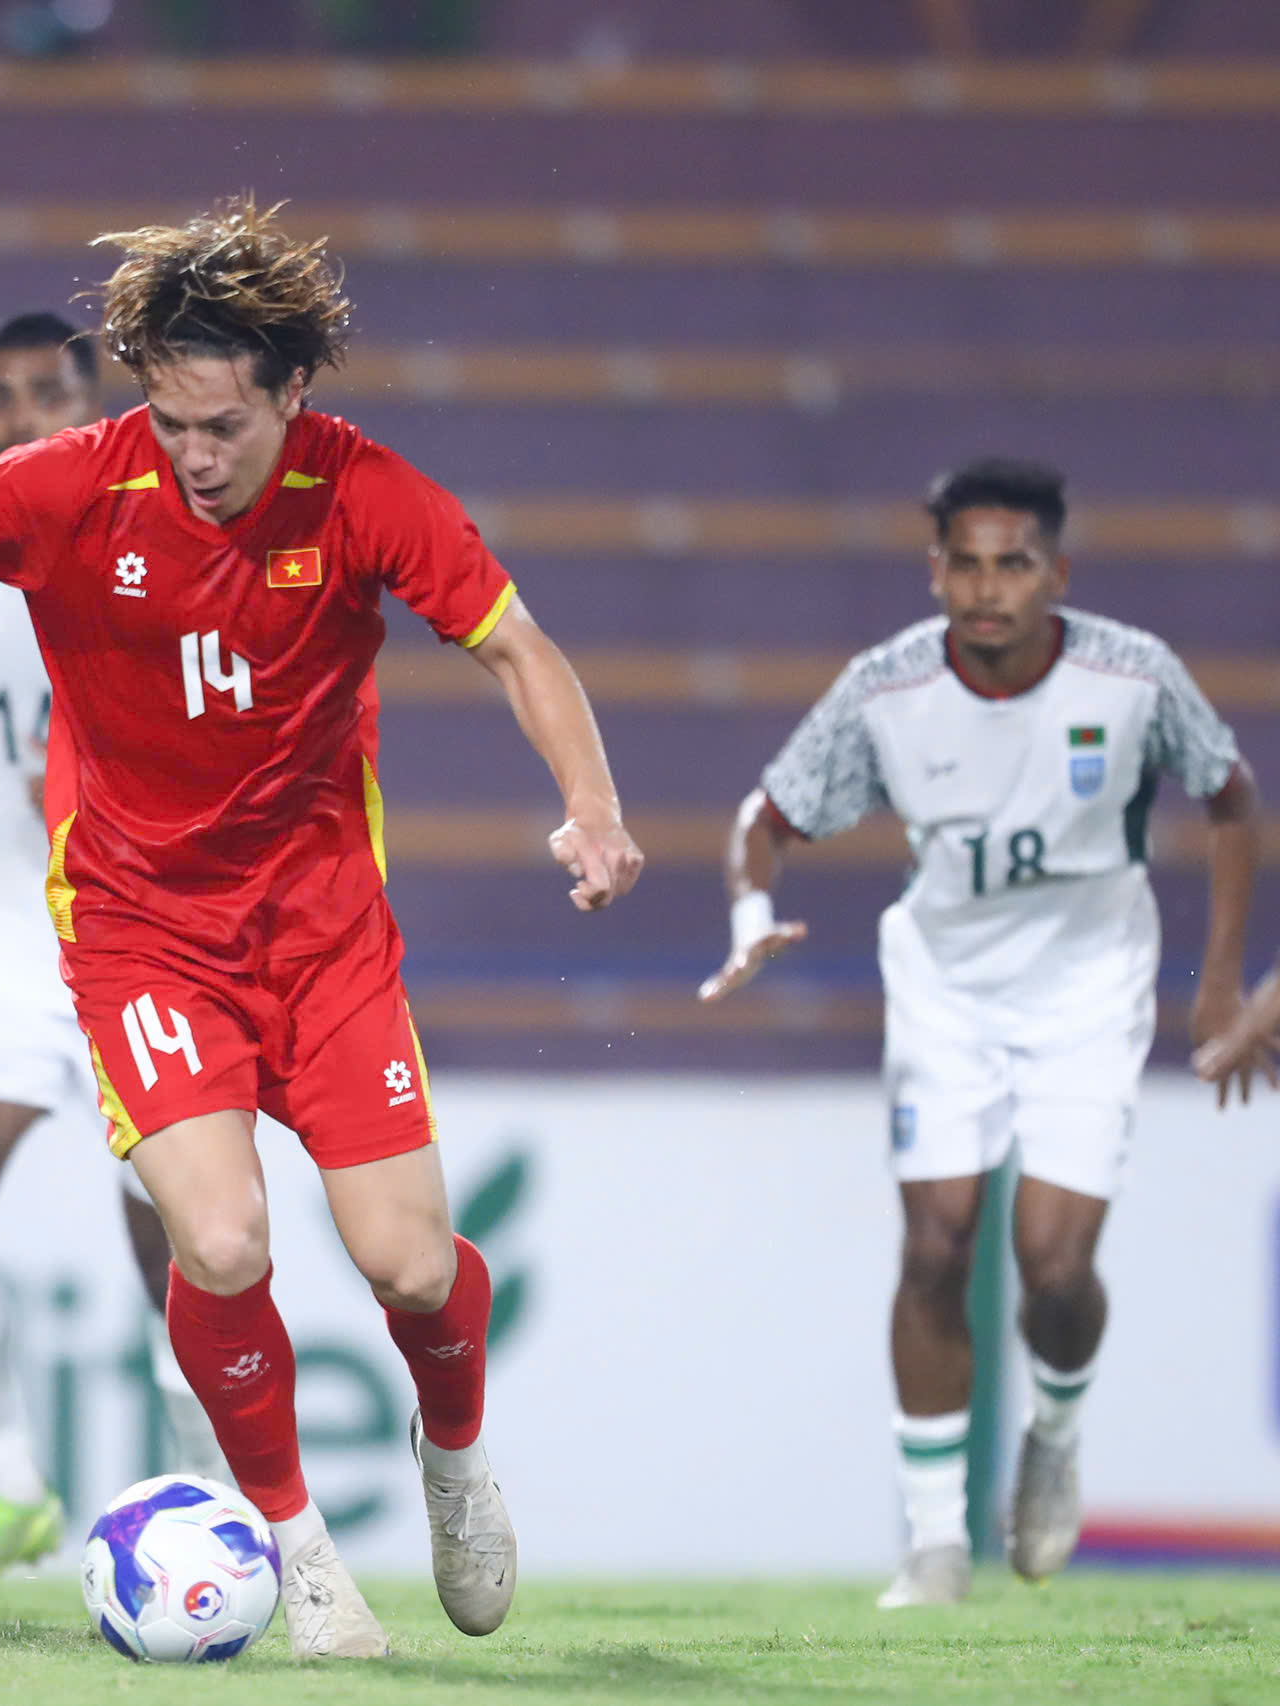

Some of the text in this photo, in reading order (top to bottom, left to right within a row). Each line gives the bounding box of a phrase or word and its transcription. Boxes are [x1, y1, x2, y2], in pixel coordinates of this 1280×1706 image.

[180, 629, 254, 720] 14
[962, 826, 1045, 896] 18
[121, 992, 203, 1092] 14
